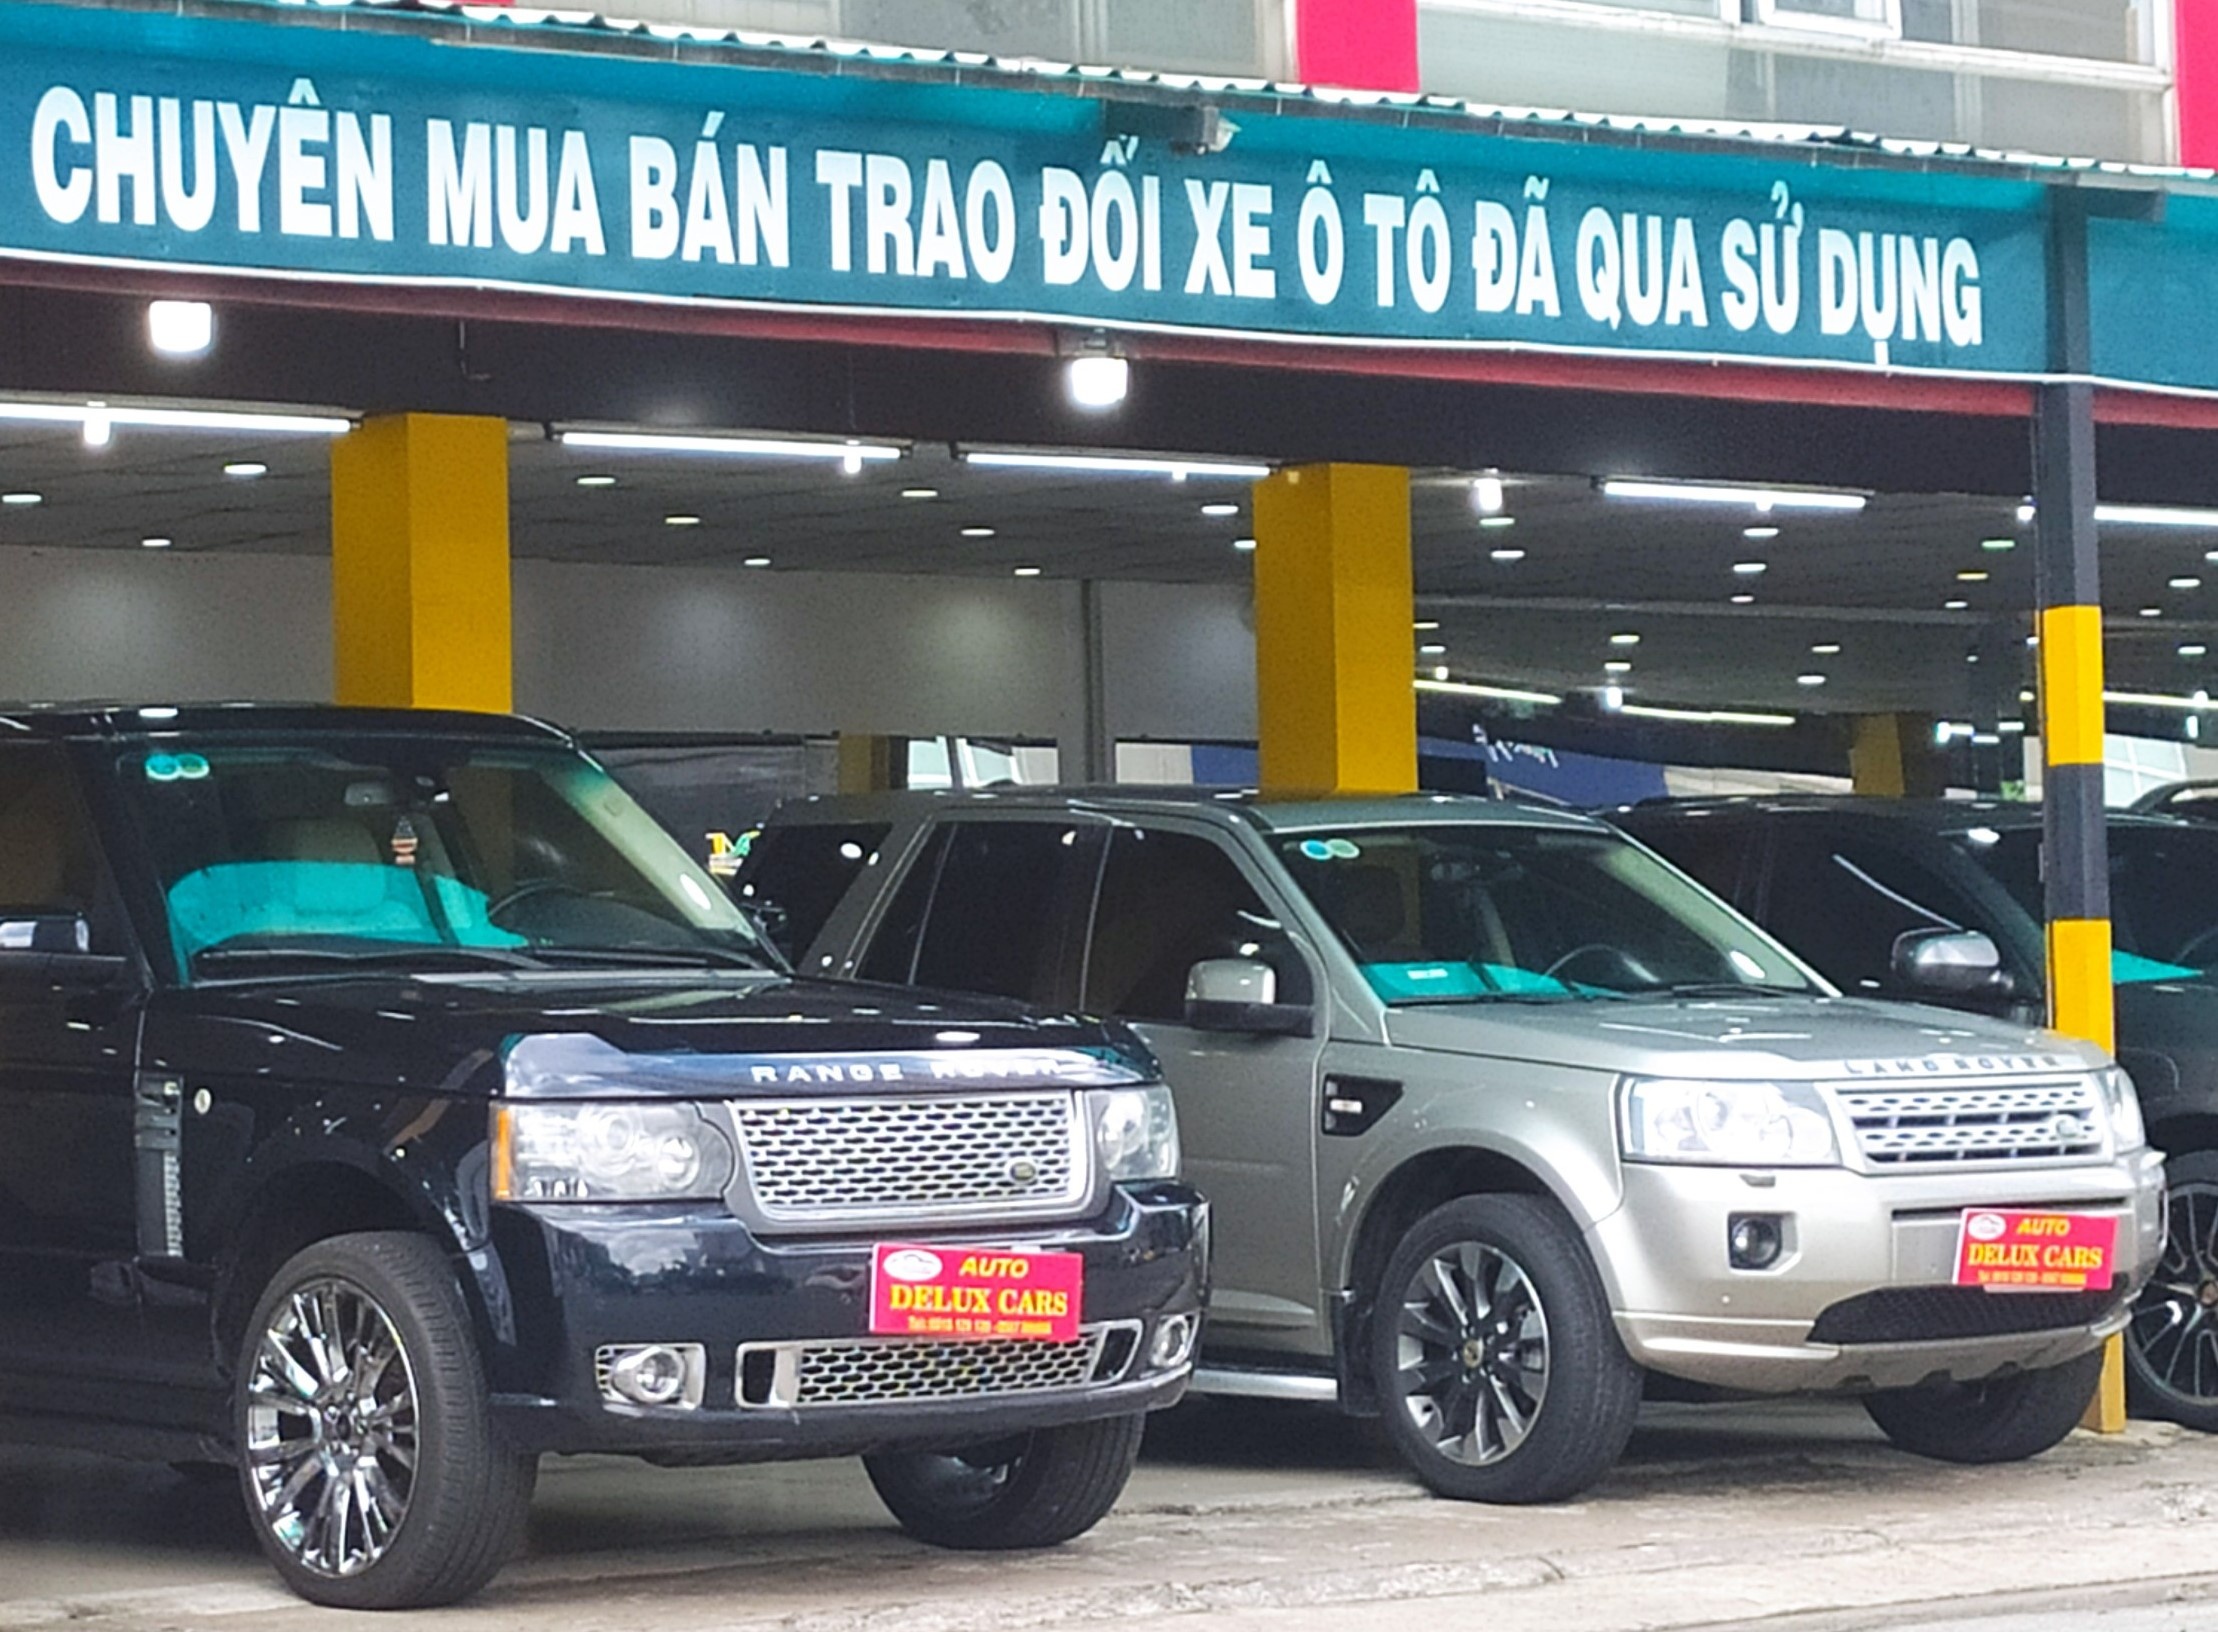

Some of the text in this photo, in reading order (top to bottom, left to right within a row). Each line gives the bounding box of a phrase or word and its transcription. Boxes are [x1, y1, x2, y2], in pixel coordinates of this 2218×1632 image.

[31, 77, 1983, 366] CHUYÊN MUA BÁN TRAO ĐỔI XE Ô TÔ ĐÃ QUA SỬ DỤNG
[750, 1063, 904, 1083] RANGE
[2016, 1217, 2070, 1237] AUTO
[958, 1256, 1030, 1279] AUTO
[1968, 1243, 2104, 1269] DELUX CARS
[889, 1283, 1069, 1317] DELUX CARS
